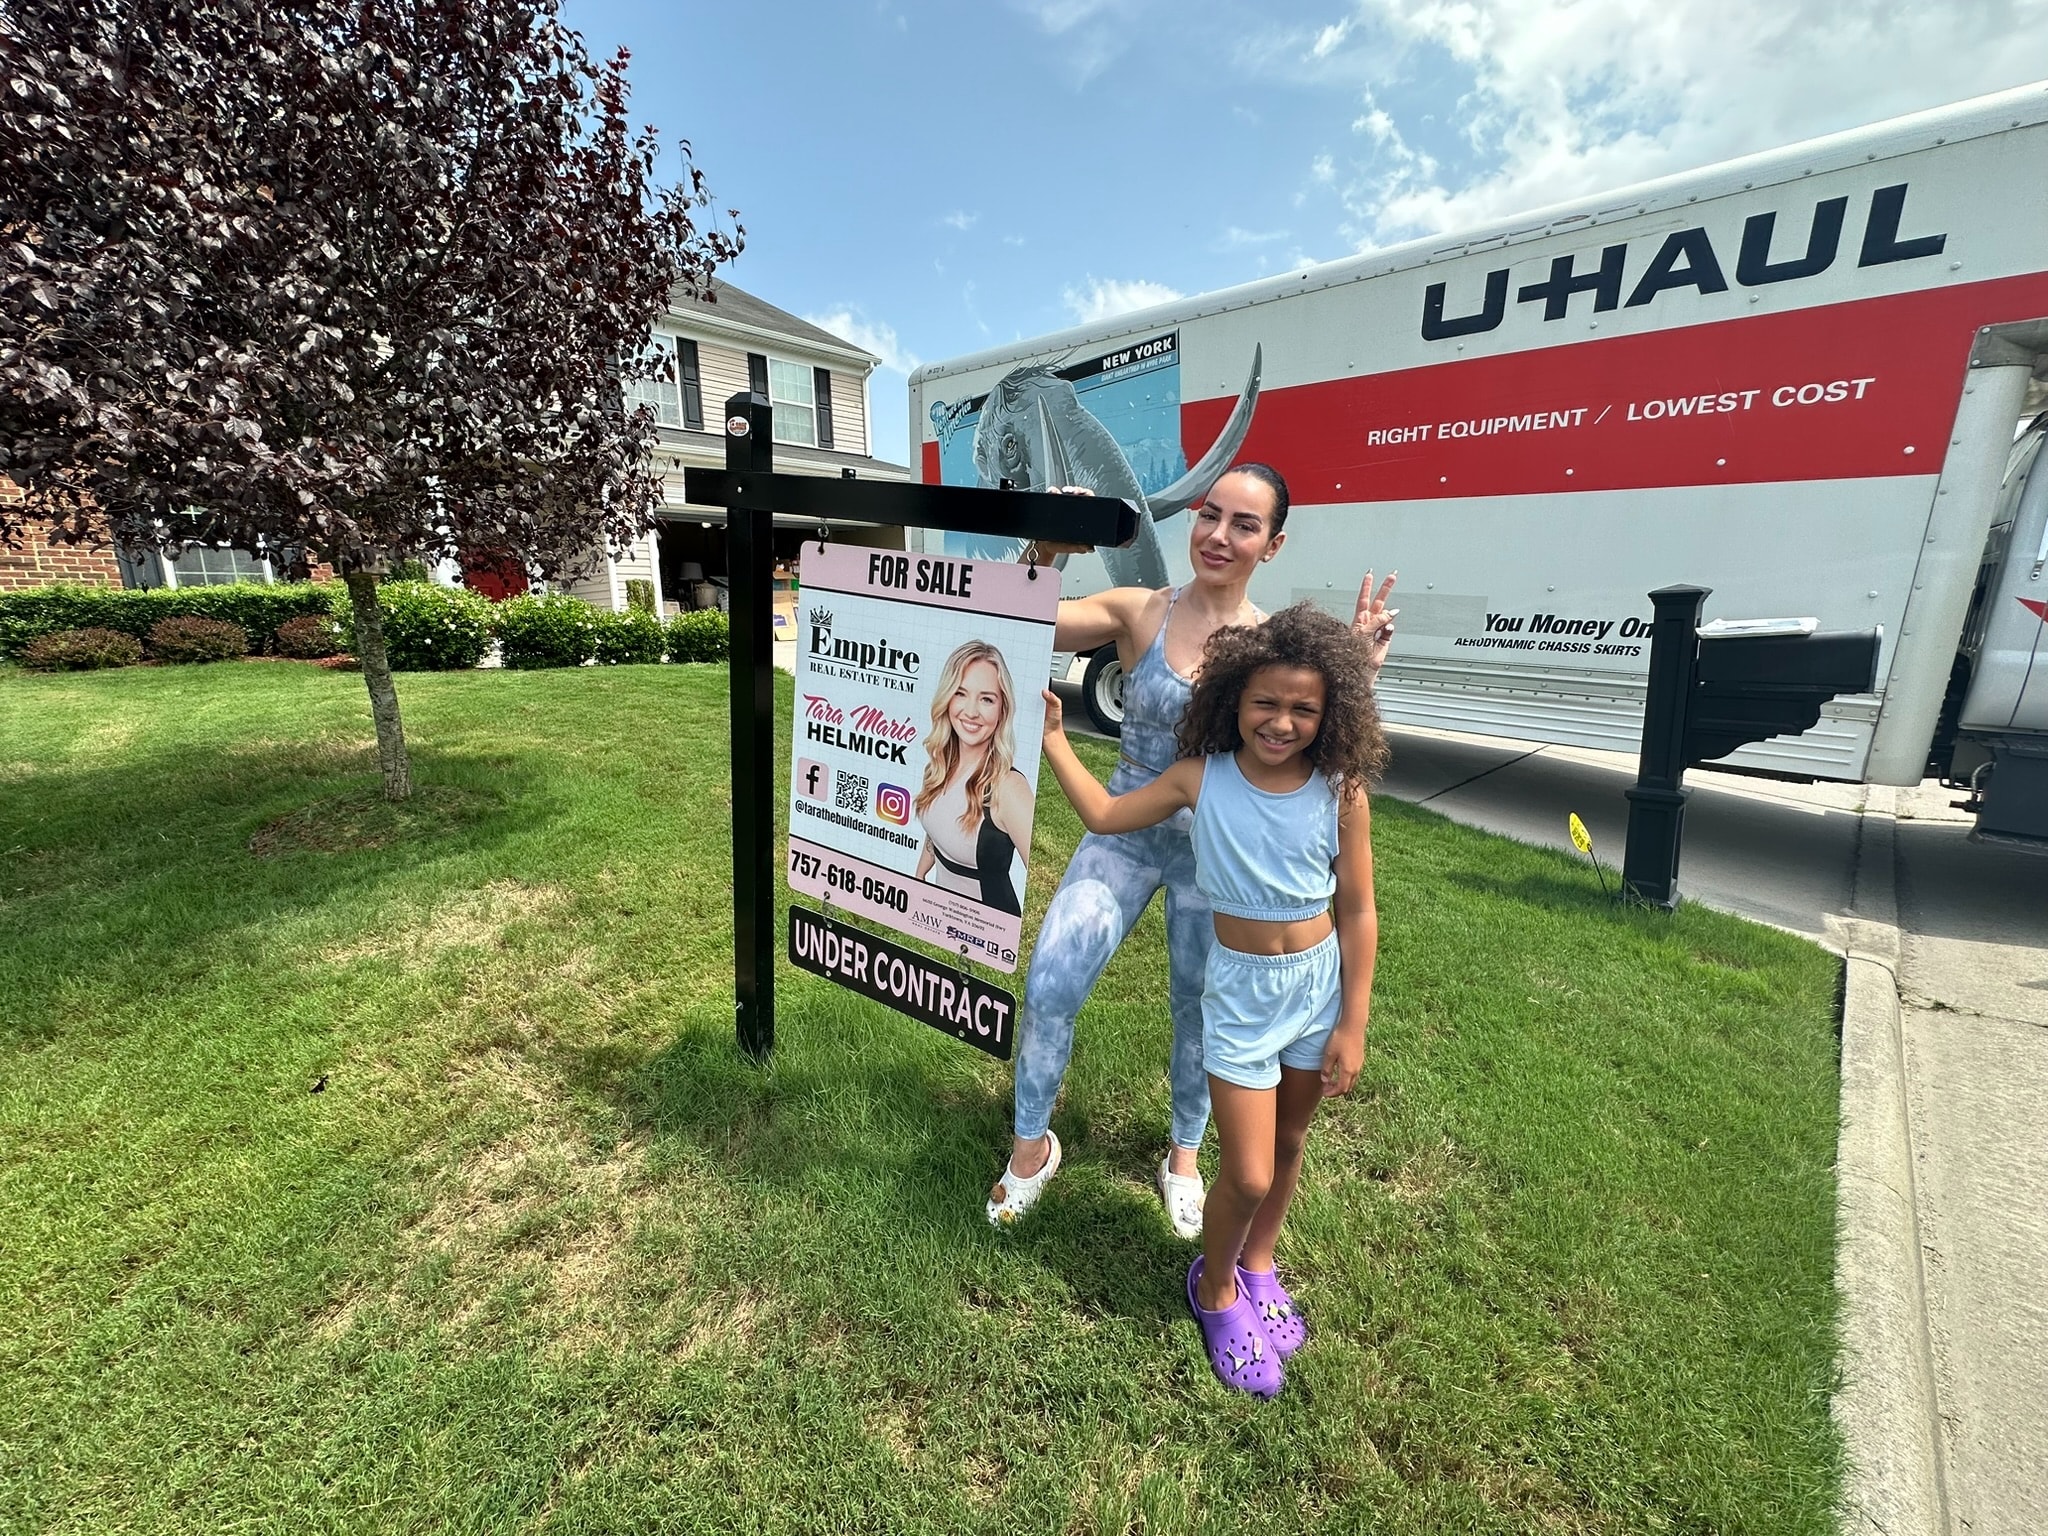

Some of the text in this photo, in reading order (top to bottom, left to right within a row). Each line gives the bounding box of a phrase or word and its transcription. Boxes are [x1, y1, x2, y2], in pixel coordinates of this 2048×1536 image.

[1421, 183, 1947, 341] U-HAUL
[1102, 337, 1172, 371] NEW YORK
[1367, 424, 1432, 446] RIGHT
[1437, 408, 1588, 440] EQUIPMENT
[1626, 389, 1760, 422] LOWEST
[1772, 377, 1876, 408] COST
[868, 553, 973, 598] FOR SALE
[1454, 637, 1641, 657] AERODYNAMIC CHASSIS SKIRTS
[1484, 613, 1654, 640] You Money On
[809, 626, 920, 675] Empire
[810, 661, 915, 694] REAL ESTATE TEAM
[803, 693, 917, 743] Tara Marie
[807, 721, 908, 766] HELMICK
[795, 799, 919, 851] @tarathebuilderandrealtor
[791, 850, 909, 914] 757-618-0540
[911, 911, 942, 929] AMW
[795, 919, 1009, 1043] UNDER CONTRACT
